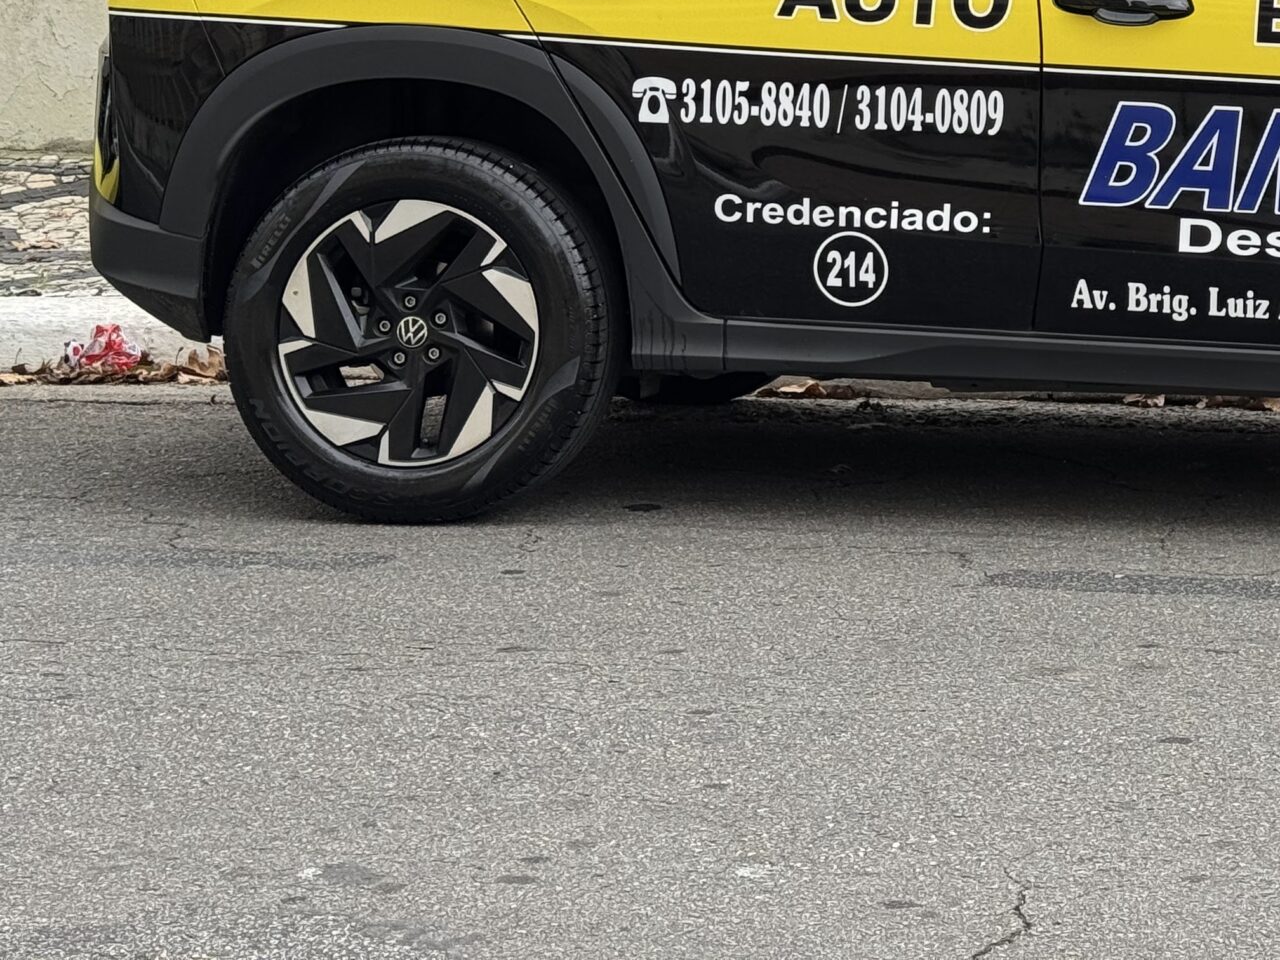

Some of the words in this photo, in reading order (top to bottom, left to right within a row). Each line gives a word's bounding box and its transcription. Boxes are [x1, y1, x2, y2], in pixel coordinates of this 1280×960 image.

[680, 78, 831, 128] 3105-8840
[854, 85, 1004, 136] 3104-0809
[714, 193, 993, 233] Credenciado:
[826, 250, 876, 288] 214
[1070, 278, 1116, 311] Av.
[1127, 282, 1197, 322] Brig.
[1208, 286, 1270, 319] Luiz
